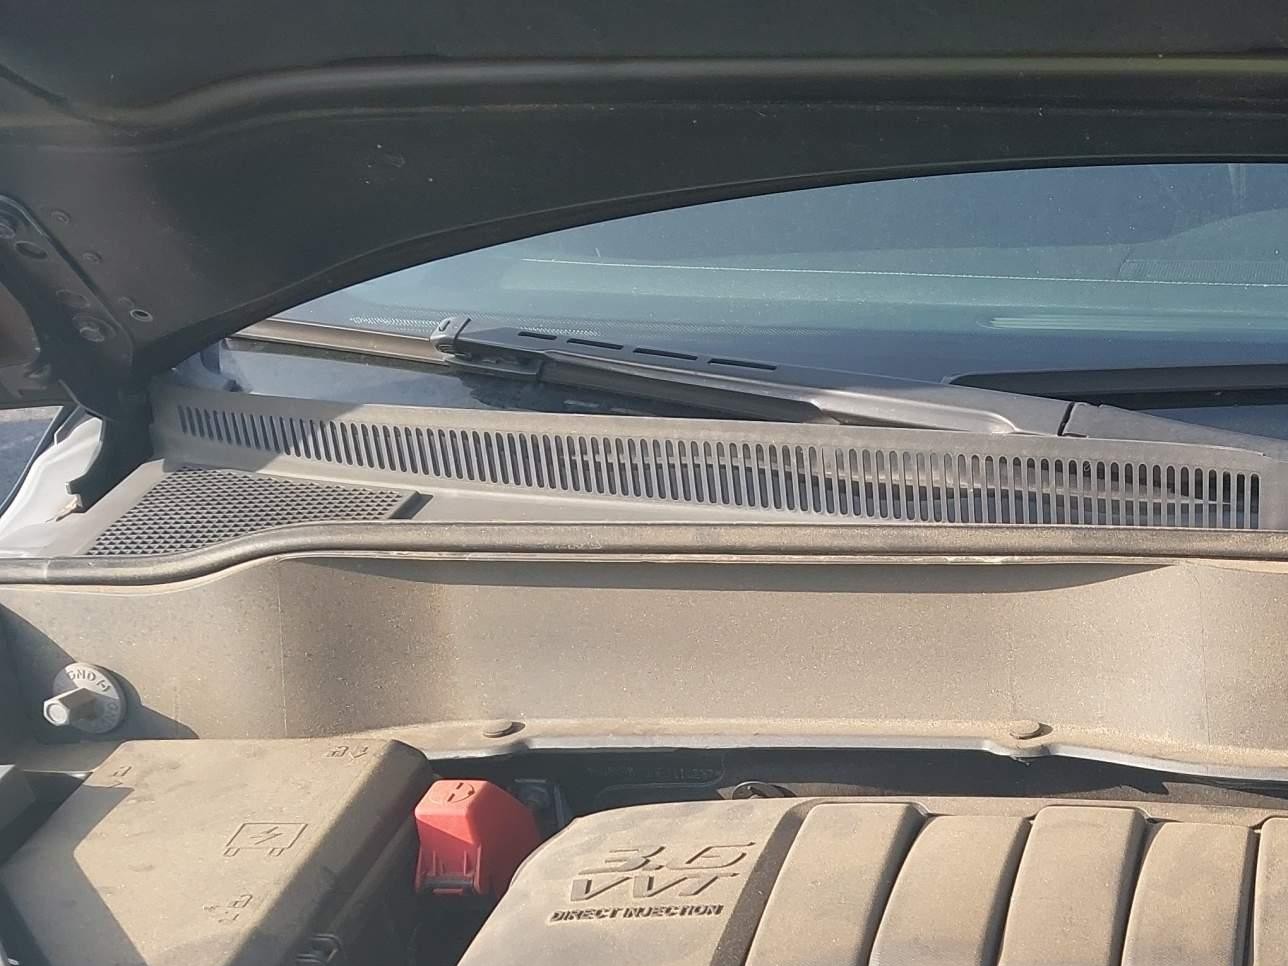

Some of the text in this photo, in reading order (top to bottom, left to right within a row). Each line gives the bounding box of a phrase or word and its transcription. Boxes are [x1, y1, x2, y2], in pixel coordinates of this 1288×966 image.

[578, 842, 756, 876] 3.6
[570, 873, 740, 901] VVT
[550, 904, 724, 922] DIRECT INJECTION
